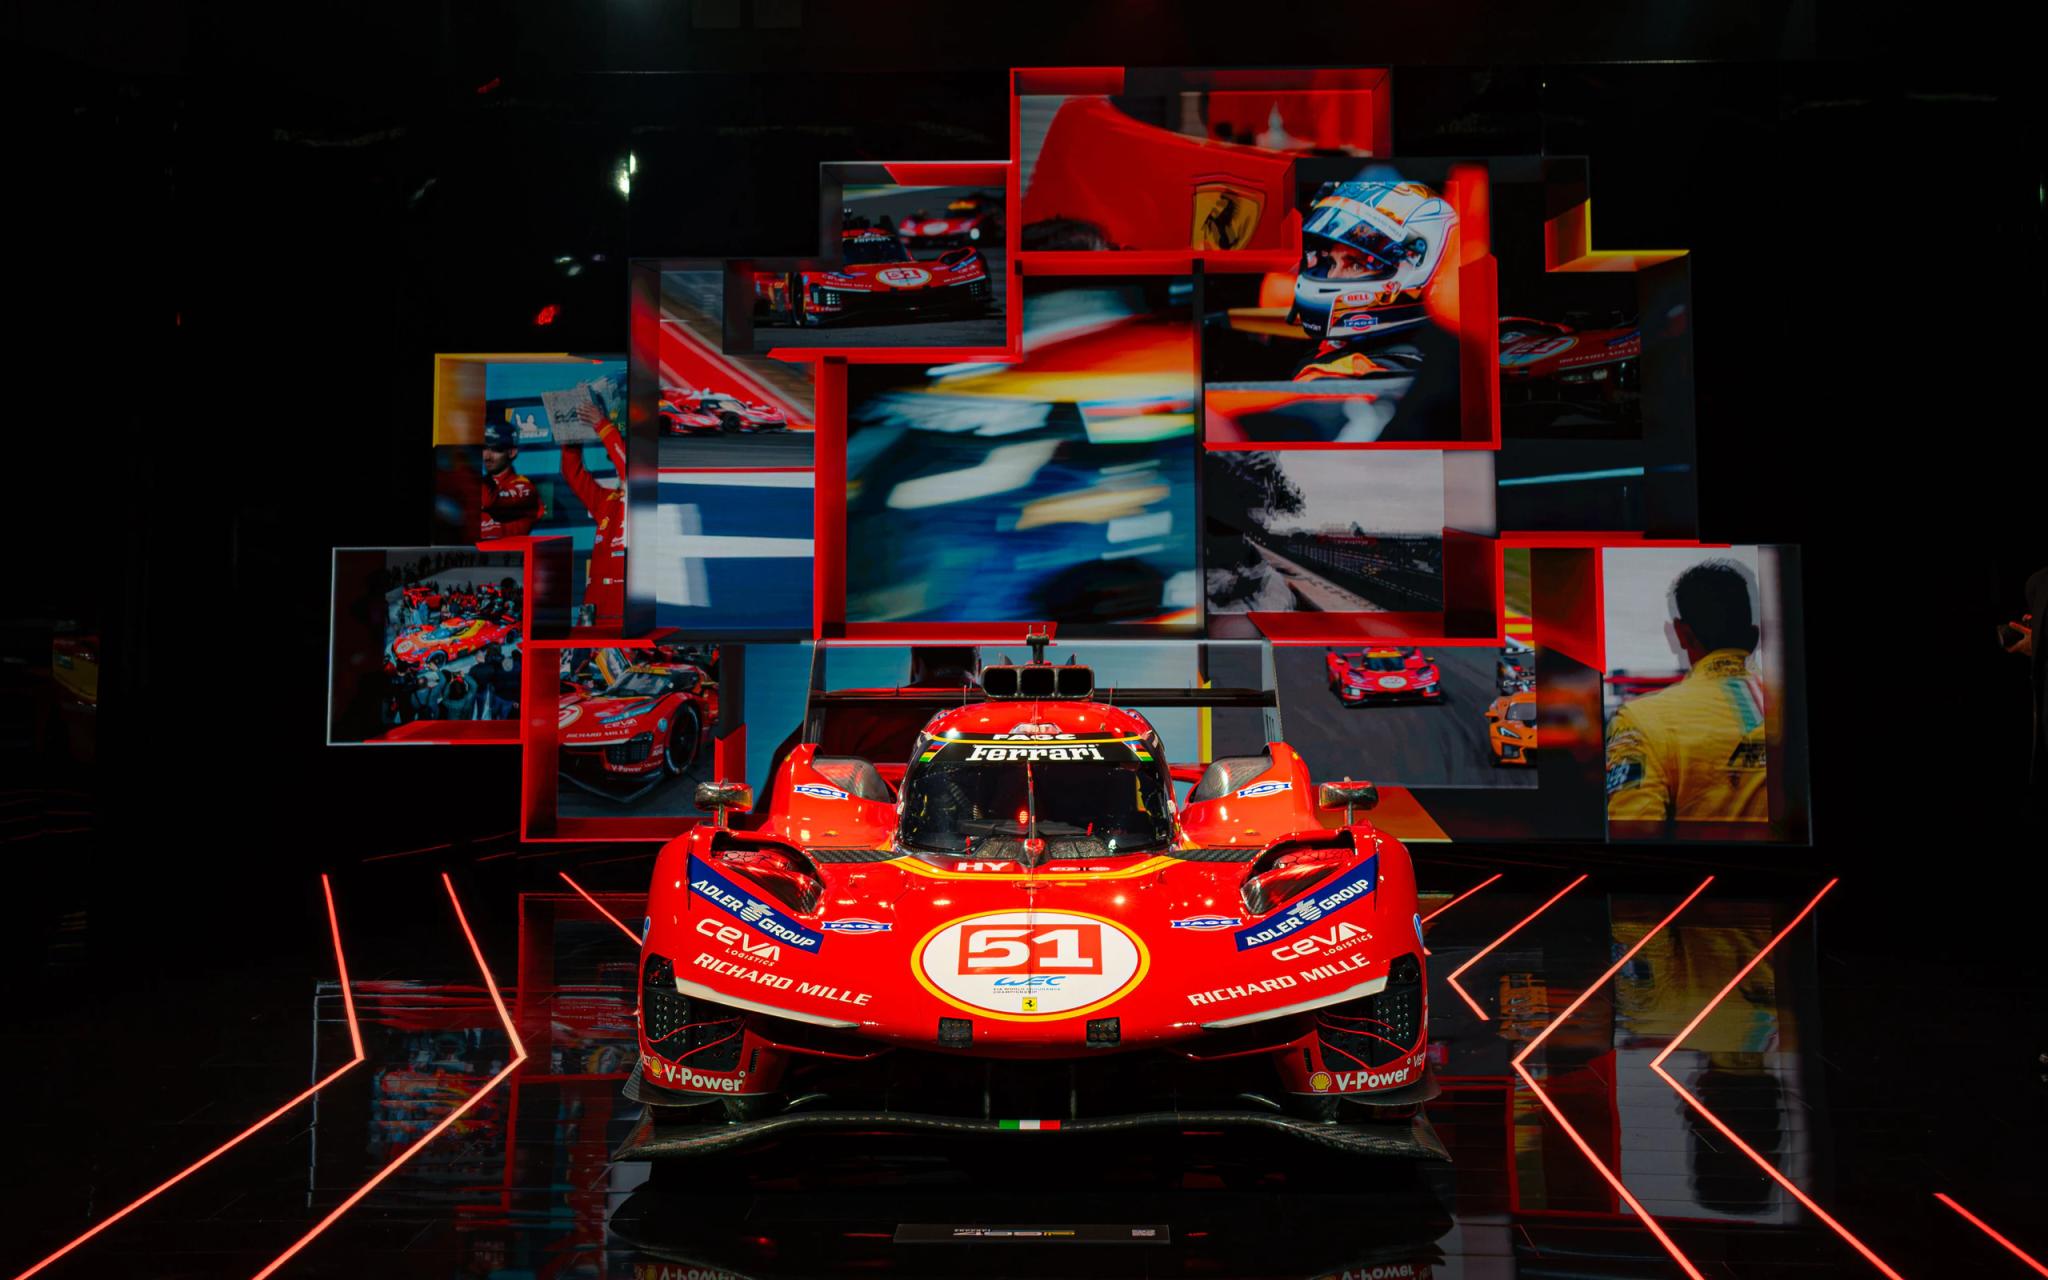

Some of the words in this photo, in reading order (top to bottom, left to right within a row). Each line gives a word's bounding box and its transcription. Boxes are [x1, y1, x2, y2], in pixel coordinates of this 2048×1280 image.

[1347, 294, 1369, 302] BELL
[965, 744, 1104, 761] Ferrari
[957, 862, 1011, 871] HY
[691, 880, 744, 912] ADLER
[758, 917, 816, 947] GROUP
[1244, 916, 1304, 947] ADLER
[1318, 878, 1369, 911] GROUP
[724, 947, 776, 967] LOGISTICS
[967, 929, 1093, 967] 51
[1322, 933, 1374, 957] LOGISTICS
[693, 952, 793, 991] RICHARD
[795, 981, 872, 1007] MILLE
[993, 975, 1067, 986] WEC
[1187, 975, 1297, 1006] RICHARD
[1299, 952, 1371, 984] MILLE
[664, 1063, 743, 1092] V-Power
[1335, 1067, 1410, 1091] V-Power
